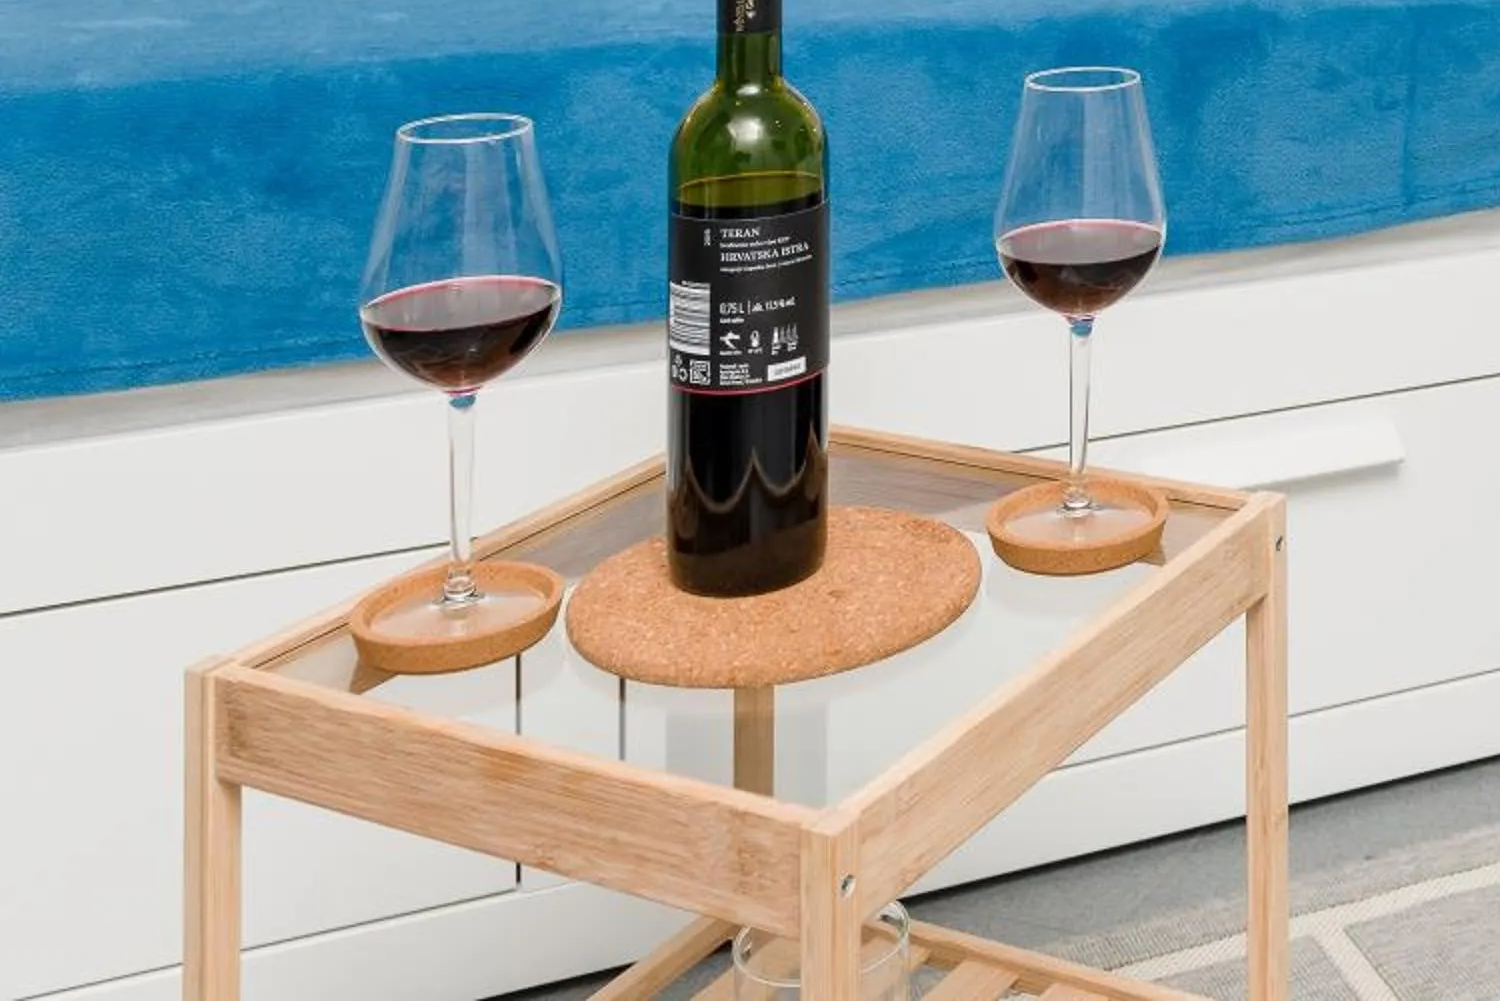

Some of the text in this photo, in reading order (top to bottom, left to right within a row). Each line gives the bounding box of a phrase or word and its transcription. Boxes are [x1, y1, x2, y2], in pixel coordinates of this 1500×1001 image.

[720, 228, 759, 238] TERAN
[720, 249, 779, 261] HRVATSKA
[781, 241, 809, 256] ISTRA
